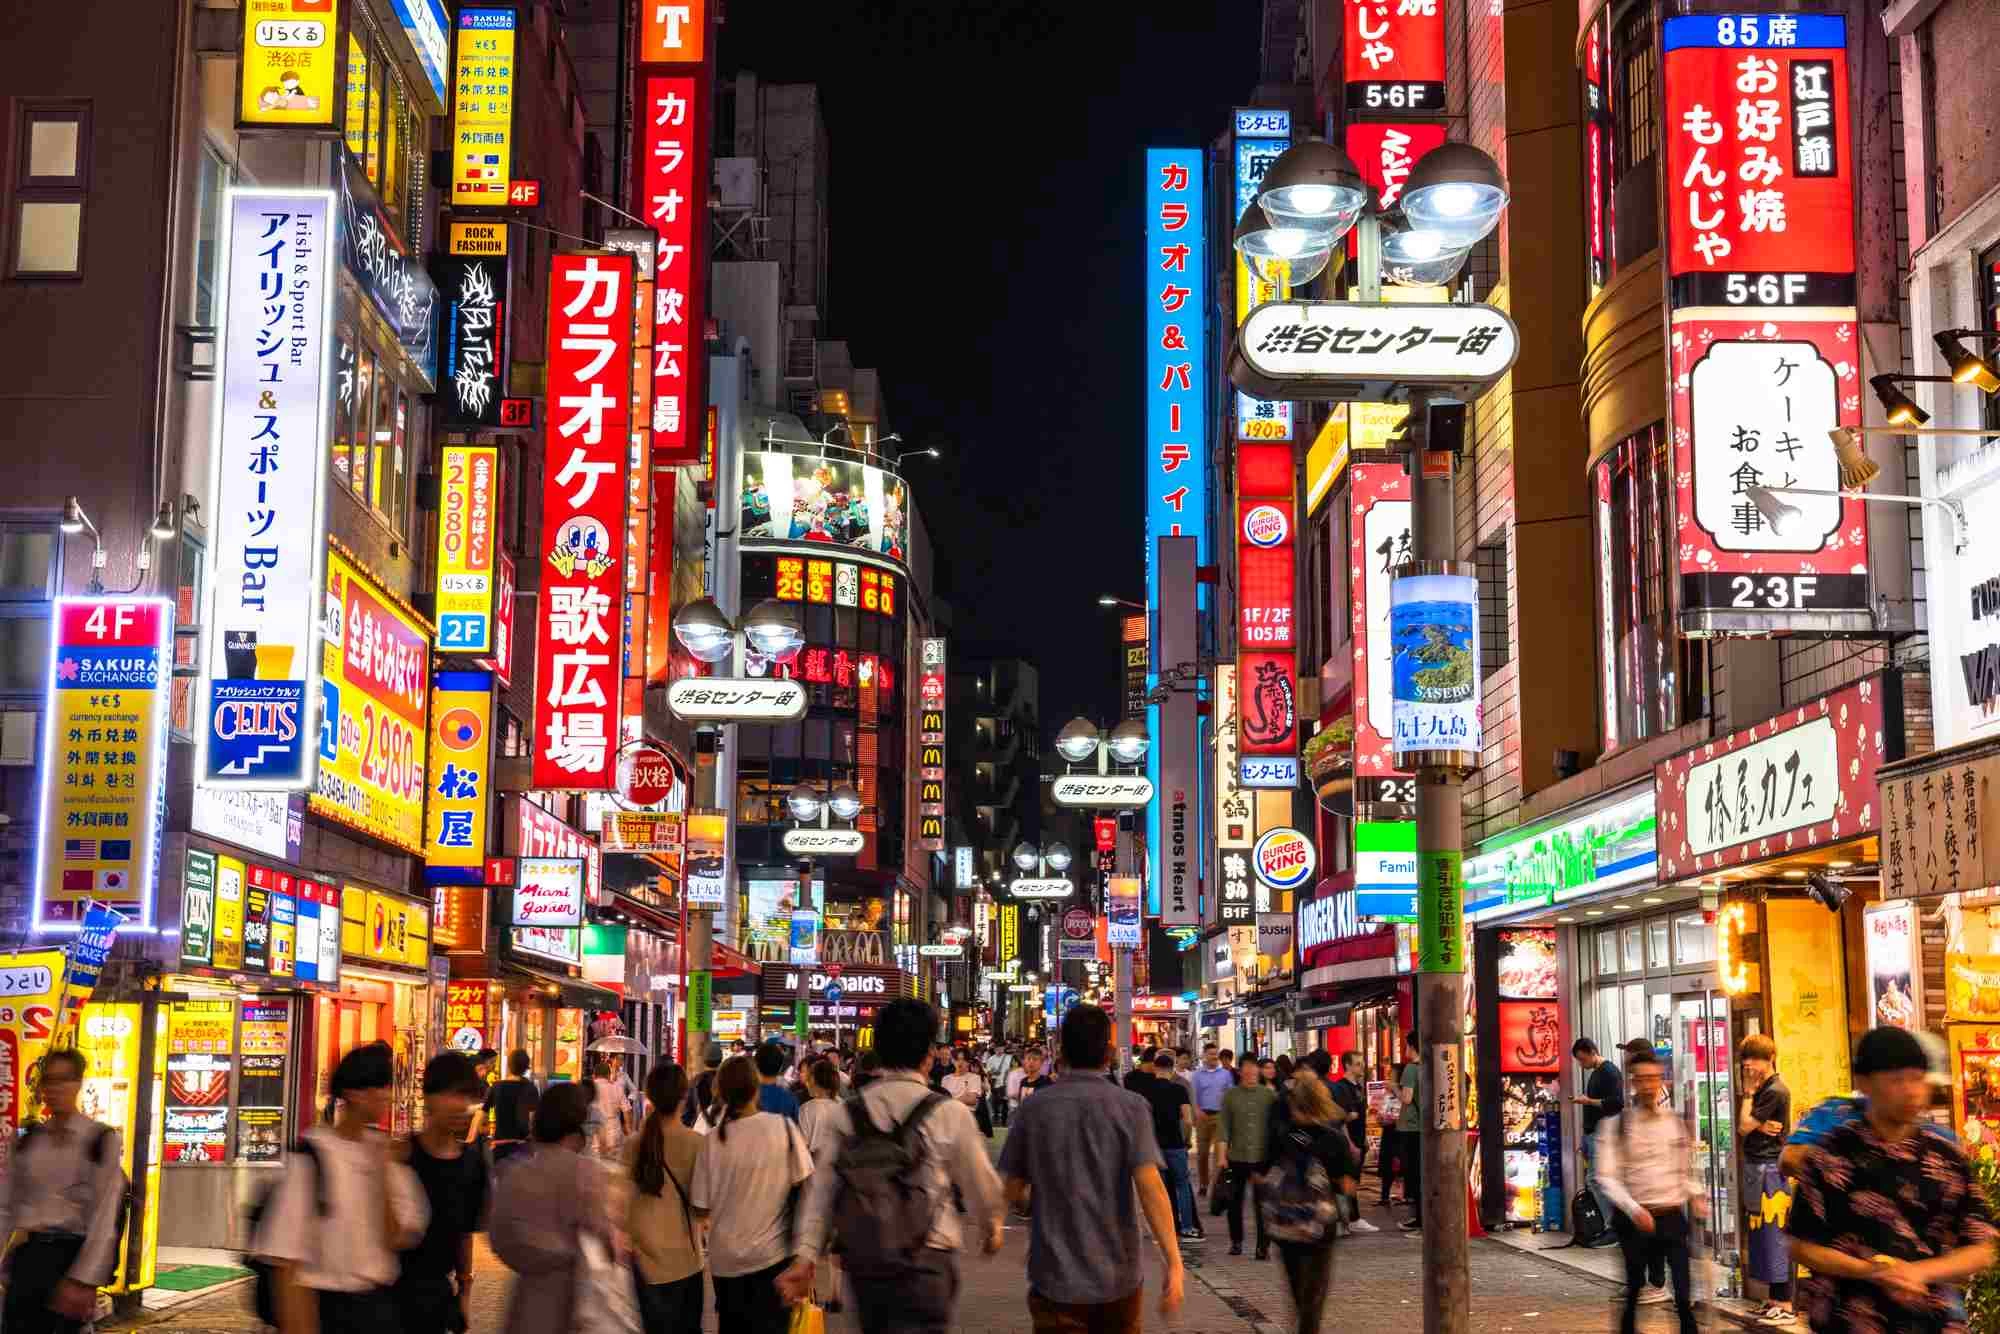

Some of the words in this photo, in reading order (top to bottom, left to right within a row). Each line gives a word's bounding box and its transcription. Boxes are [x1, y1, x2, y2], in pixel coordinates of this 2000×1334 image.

[262, 26, 318, 41] りらくる
[1717, 16, 1797, 46] 85席
[266, 50, 312, 68] 渋谷店
[1238, 114, 1288, 130] センタービル
[1795, 65, 1831, 172] 江戸前
[1735, 55, 1787, 232] お好み焼
[511, 186, 536, 202] 4F
[1682, 104, 1731, 266] もんじゃ
[295, 213, 313, 259] Irish
[465, 228, 495, 239] ROCK
[457, 241, 501, 251] FASHION
[294, 264, 308, 275] &
[289, 279, 312, 331] Sport
[1256, 325, 1503, 356] 渋谷センター街
[290, 337, 308, 367] Bar
[554, 257, 621, 509] カラオケ
[506, 403, 525, 421] 3F
[1729, 424, 1764, 536] お食事
[471, 457, 490, 565] 全身もみほぐし
[1251, 515, 1280, 529] BURGER
[1252, 523, 1282, 538] KING
[241, 543, 279, 612] Bar
[445, 578, 485, 590] りらくる
[85, 605, 136, 640] 4F
[447, 619, 481, 641] 2F
[1245, 627, 1289, 641] 105席
[228, 641, 257, 649] GUINNESS
[348, 600, 424, 710] 全身もみほぐし
[81, 658, 159, 671] SAKURA
[545, 586, 612, 774] 歌広場
[675, 690, 797, 706] 渋谷センター街
[1414, 685, 1472, 699] SASEBO
[214, 701, 297, 741] CELTS
[1241, 764, 1296, 780] センタービル
[1059, 784, 1150, 796] 渋谷センター街
[437, 763, 479, 847] 松屋
[1172, 791, 1187, 856] atmos
[1922, 775, 1938, 891] チャーハン
[1262, 841, 1304, 861] BURGER
[1264, 850, 1307, 875] KING
[519, 883, 572, 898] Miami
[1172, 861, 1187, 912] Heart
[1223, 907, 1249, 918] B1F
[1231, 927, 1256, 944] すし
[1258, 925, 1292, 935] SUSHI
